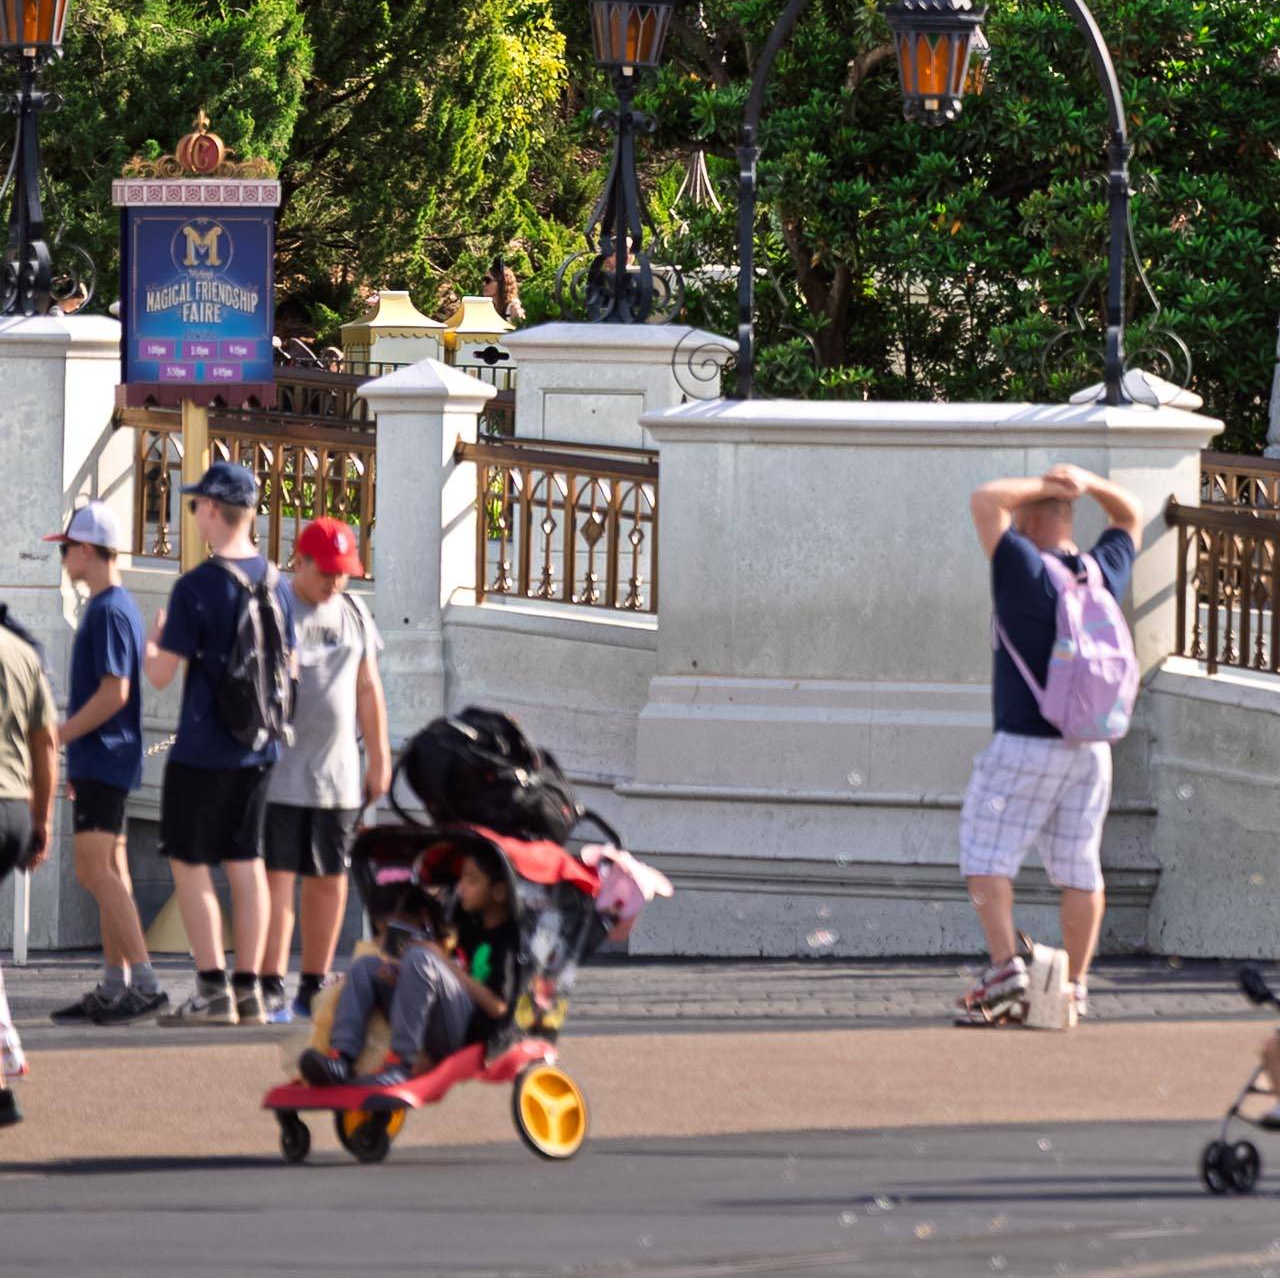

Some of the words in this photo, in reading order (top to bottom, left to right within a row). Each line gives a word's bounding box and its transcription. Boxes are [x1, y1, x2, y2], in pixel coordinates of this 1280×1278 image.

[182, 225, 222, 267] M
[146, 281, 193, 312] MAGICAL
[195, 281, 259, 313] FRIENDSHIP
[182, 303, 222, 323] FAIRE
